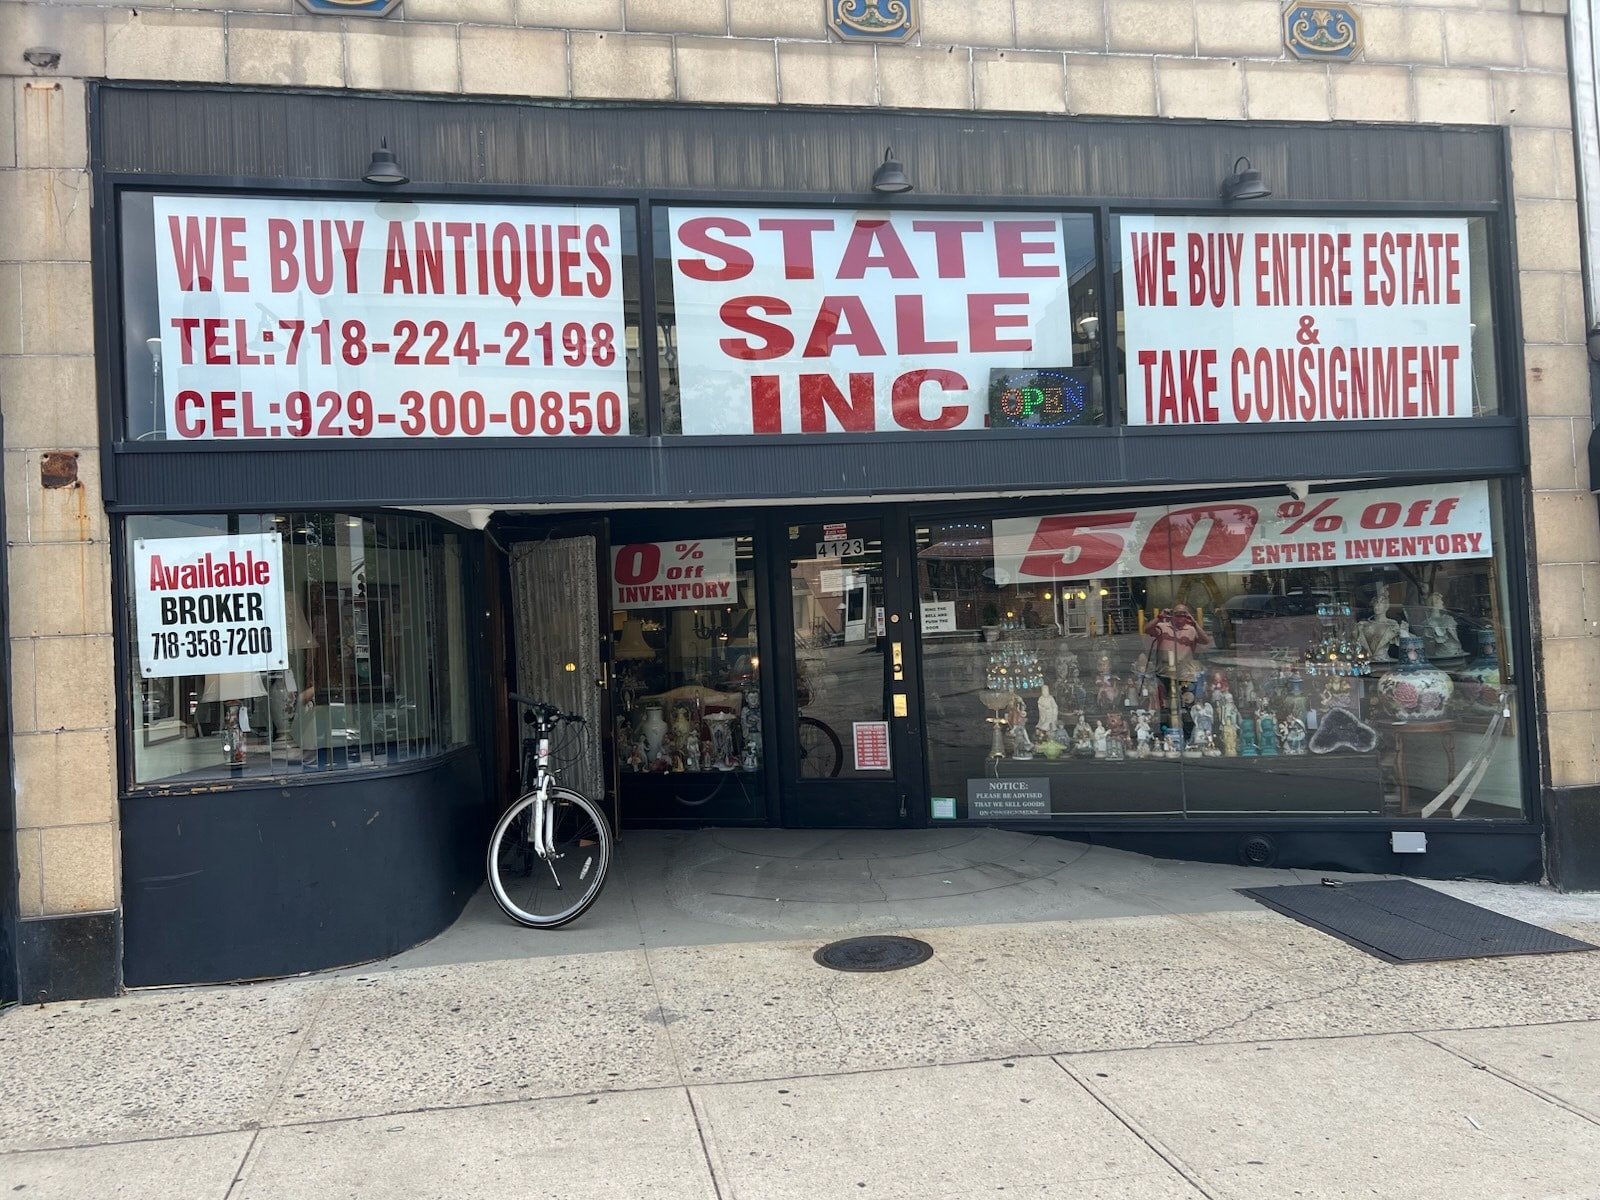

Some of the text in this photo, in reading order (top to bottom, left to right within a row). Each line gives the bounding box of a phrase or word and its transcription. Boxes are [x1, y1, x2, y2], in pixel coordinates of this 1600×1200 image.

[168, 215, 612, 306] WE BUY ANTIQUES
[677, 216, 1060, 282] STATE
[1131, 231, 1461, 308] WE BUY ENTIRE ESTATE
[170, 317, 617, 367] TEL:718-224-2198
[719, 292, 1033, 360] SALE
[1296, 314, 1320, 345] &
[750, 368, 990, 435] INC
[1001, 386, 1085, 416] OPEN
[1138, 345, 1460, 424] TAKE CONSIGNMENT
[174, 390, 622, 439] CEL:929-300-0850
[818, 540, 863, 557] 4123
[1251, 532, 1483, 564] ENTIRE INVENTORY
[150, 550, 270, 591] Available
[160, 592, 264, 625] BROKER
[618, 581, 730, 603] INVENTORY
[151, 626, 273, 660] 718-358-7200
[989, 782, 1028, 790] NOTICE:
